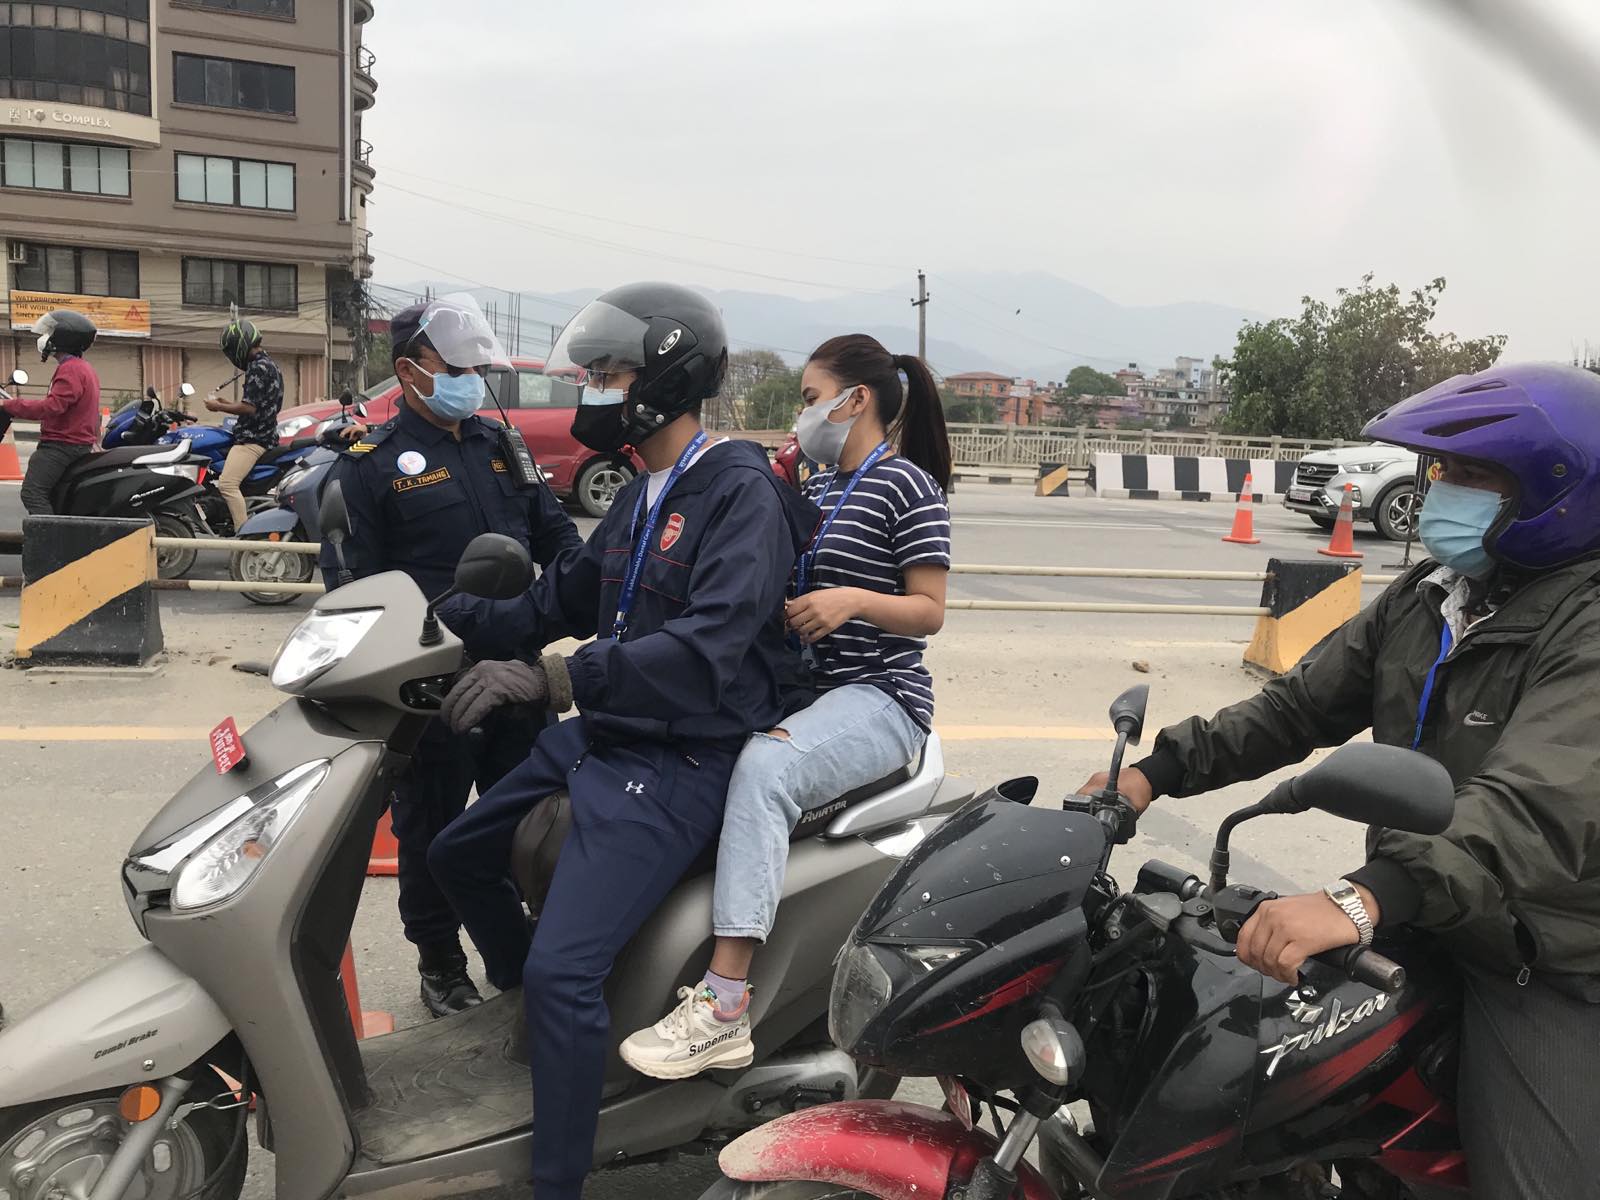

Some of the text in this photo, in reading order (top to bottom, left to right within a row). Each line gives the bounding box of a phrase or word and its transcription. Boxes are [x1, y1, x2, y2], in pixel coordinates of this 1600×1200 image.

[52, 110, 111, 128] COMPLEX
[30, 304, 55, 312] WORLD
[94, 1040, 127, 1059] Combi
